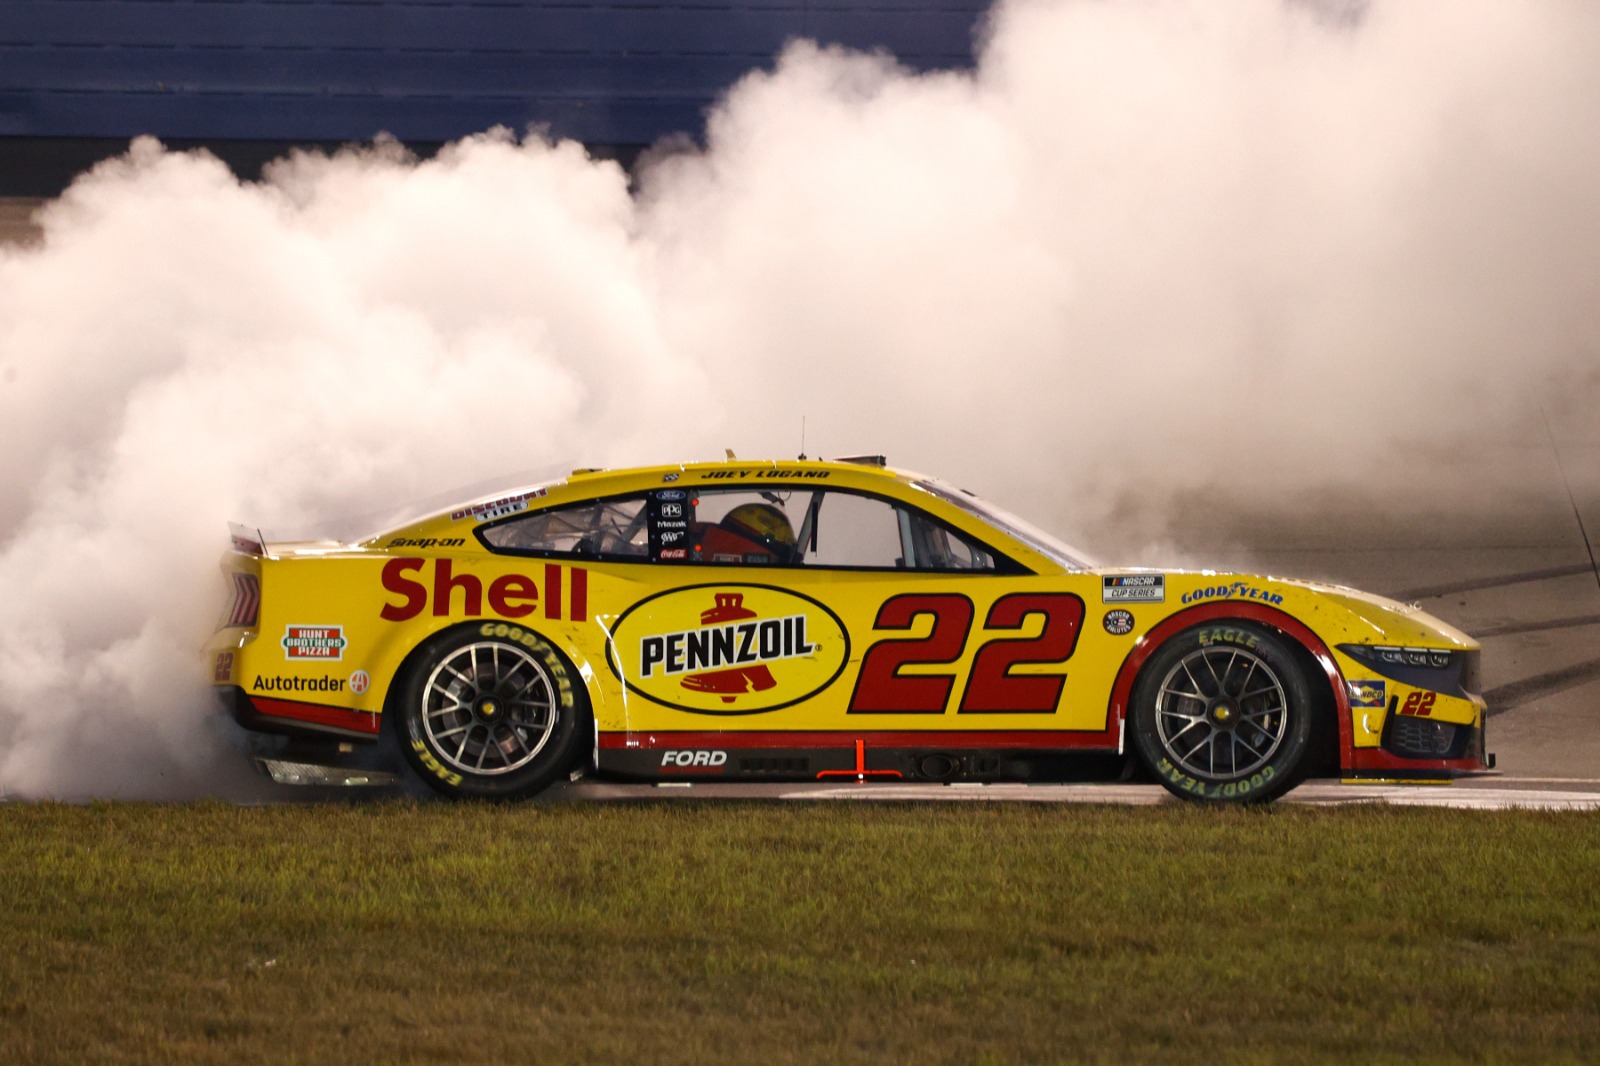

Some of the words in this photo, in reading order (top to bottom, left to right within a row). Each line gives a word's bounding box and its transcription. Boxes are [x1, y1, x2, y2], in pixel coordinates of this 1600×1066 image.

[701, 470, 751, 479] JOEY
[756, 470, 830, 478] LOGANO
[452, 487, 548, 521] DISCOUNT
[481, 503, 523, 519] TIRE
[663, 505, 680, 515] PPG
[657, 520, 687, 528] Mazak
[1122, 576, 1155, 586] NASCAR
[380, 557, 588, 622] Shell
[1111, 588, 1127, 598] CUP
[1128, 588, 1156, 597] SERIES
[1107, 611, 1130, 620] NASCAR
[299, 630, 330, 639] HUNT
[1106, 624, 1131, 634] SALUTES
[286, 638, 342, 648] BROTHERS
[1198, 628, 1259, 648] EAGLE
[298, 647, 330, 656] PIZZA
[640, 614, 816, 679] PENNZOIL
[846, 591, 1086, 714] 22
[215, 652, 234, 682] 22
[253, 674, 346, 692] Autotrader
[1401, 692, 1437, 716] 22
[411, 738, 464, 787] EAGLE
[661, 750, 728, 766] FORD
